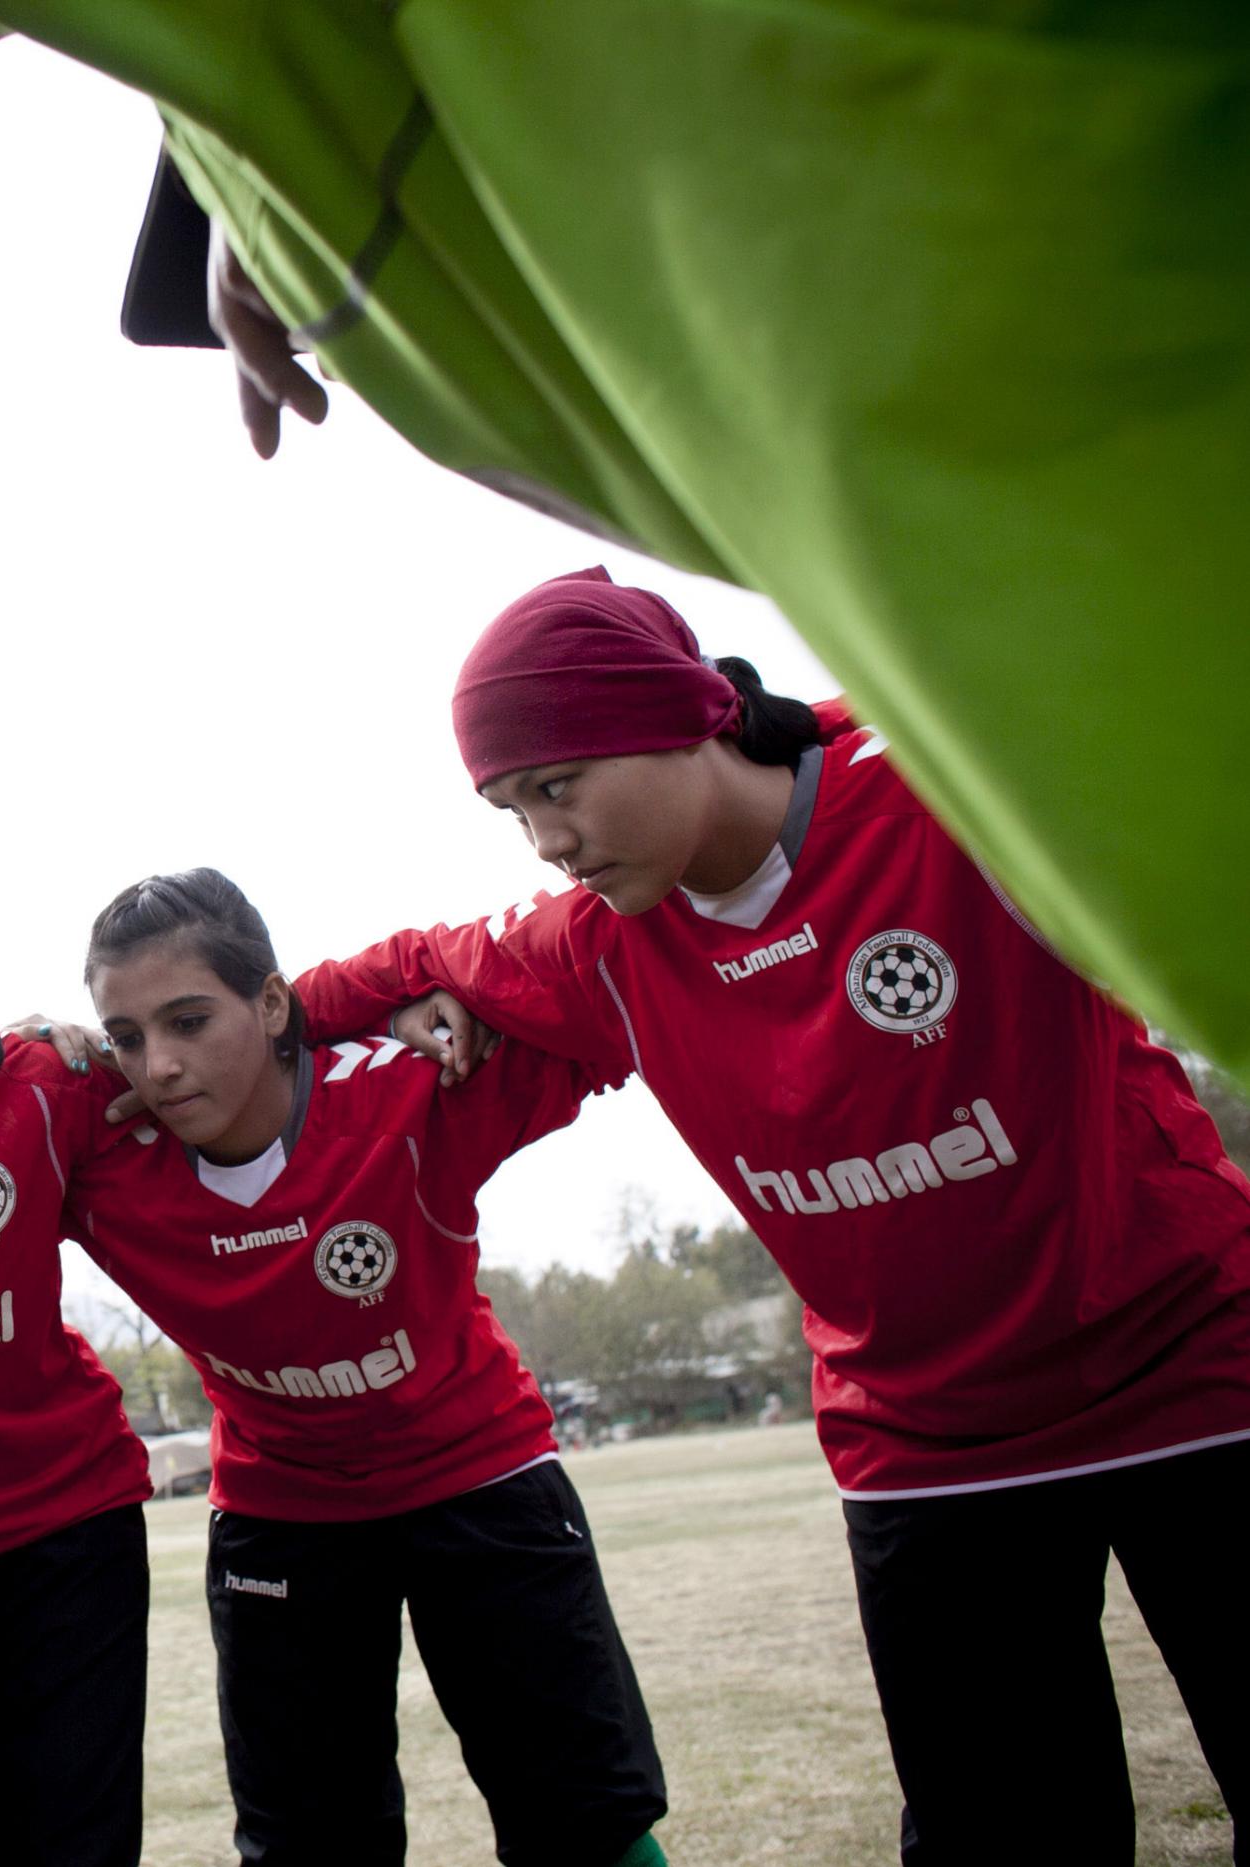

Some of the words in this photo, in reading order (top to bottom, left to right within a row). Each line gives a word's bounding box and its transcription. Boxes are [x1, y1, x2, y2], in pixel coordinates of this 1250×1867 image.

[713, 922, 819, 984] hummel
[853, 953, 869, 1010] Afghanistan
[867, 933, 908, 953] Football
[912, 934, 951, 978] Federation
[913, 1023, 947, 1049] AFF
[735, 1098, 1018, 1215] hummel
[210, 1216, 309, 1256] hummel
[359, 1290, 386, 1309] AFF
[202, 1328, 417, 1398] hummel
[225, 1569, 288, 1598] hummel
